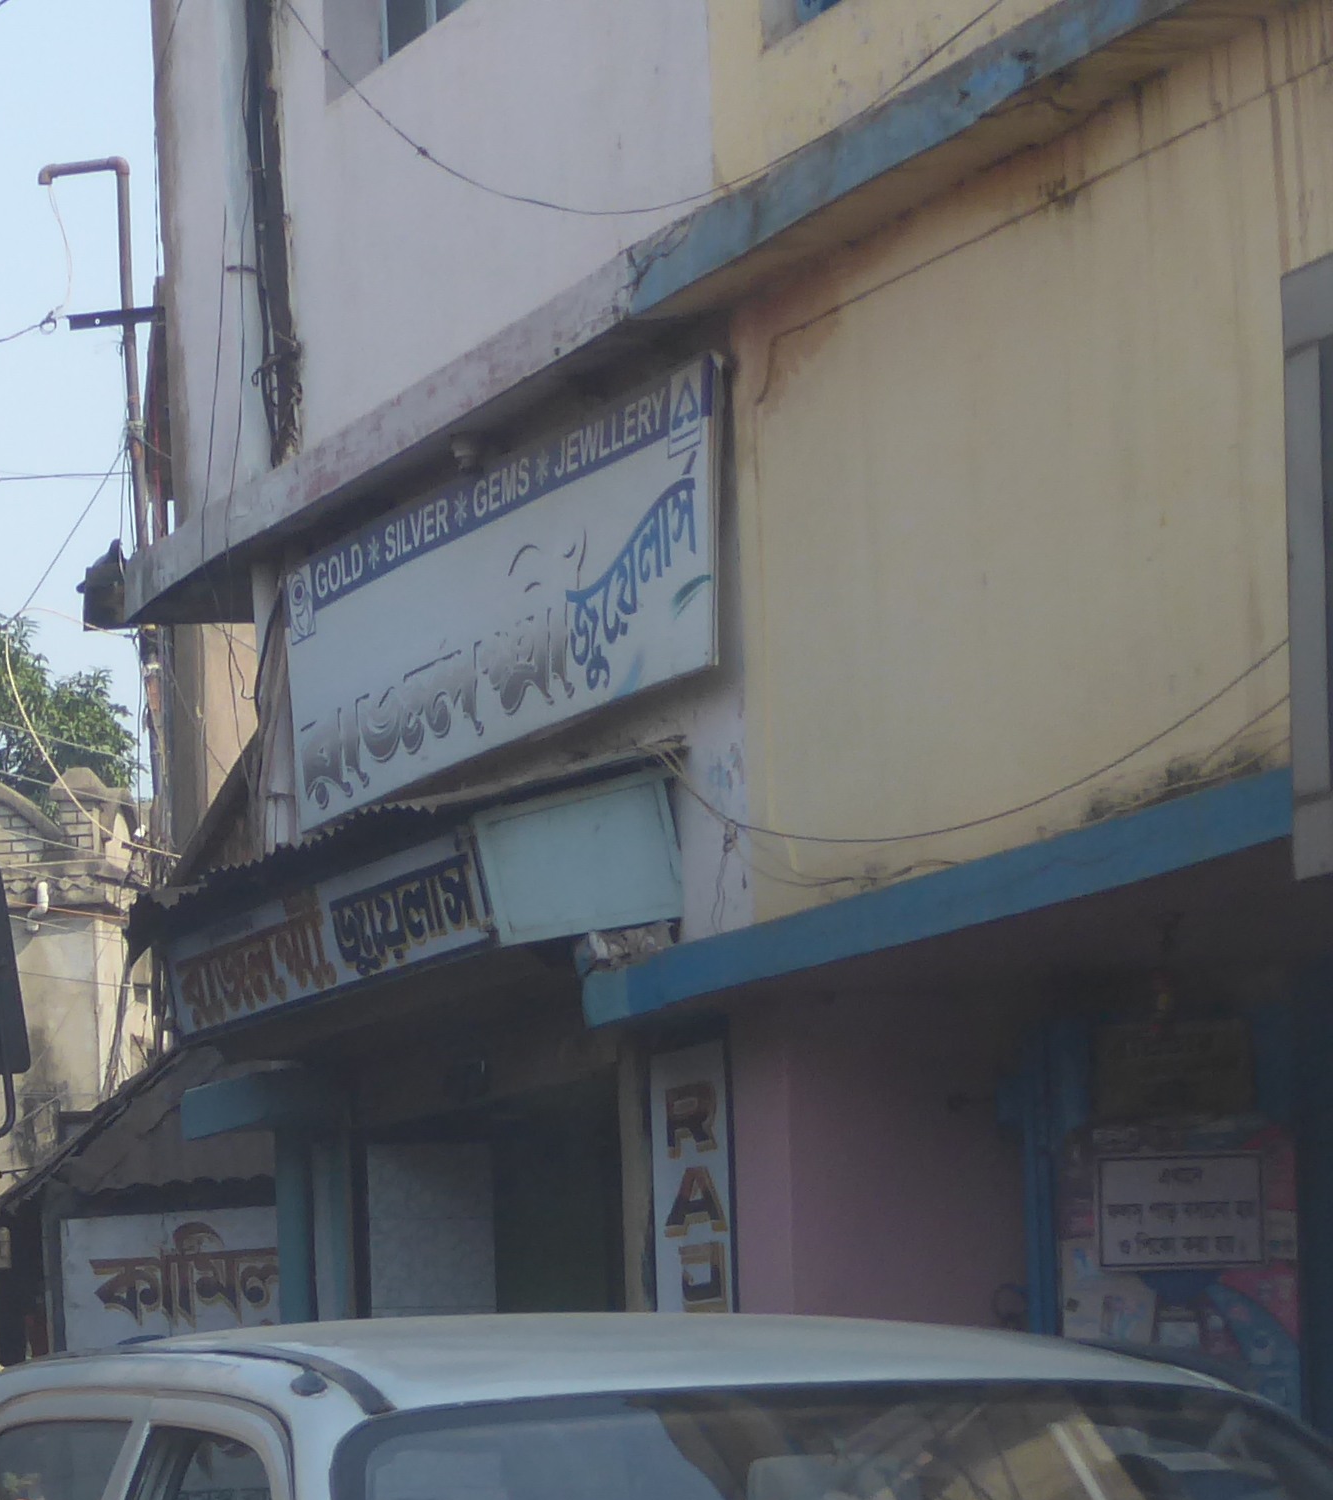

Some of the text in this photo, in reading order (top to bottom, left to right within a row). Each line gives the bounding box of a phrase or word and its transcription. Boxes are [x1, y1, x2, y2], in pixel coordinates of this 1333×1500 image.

[314, 389, 667, 598] GOLD SILVER GEMS JEWLLERY
